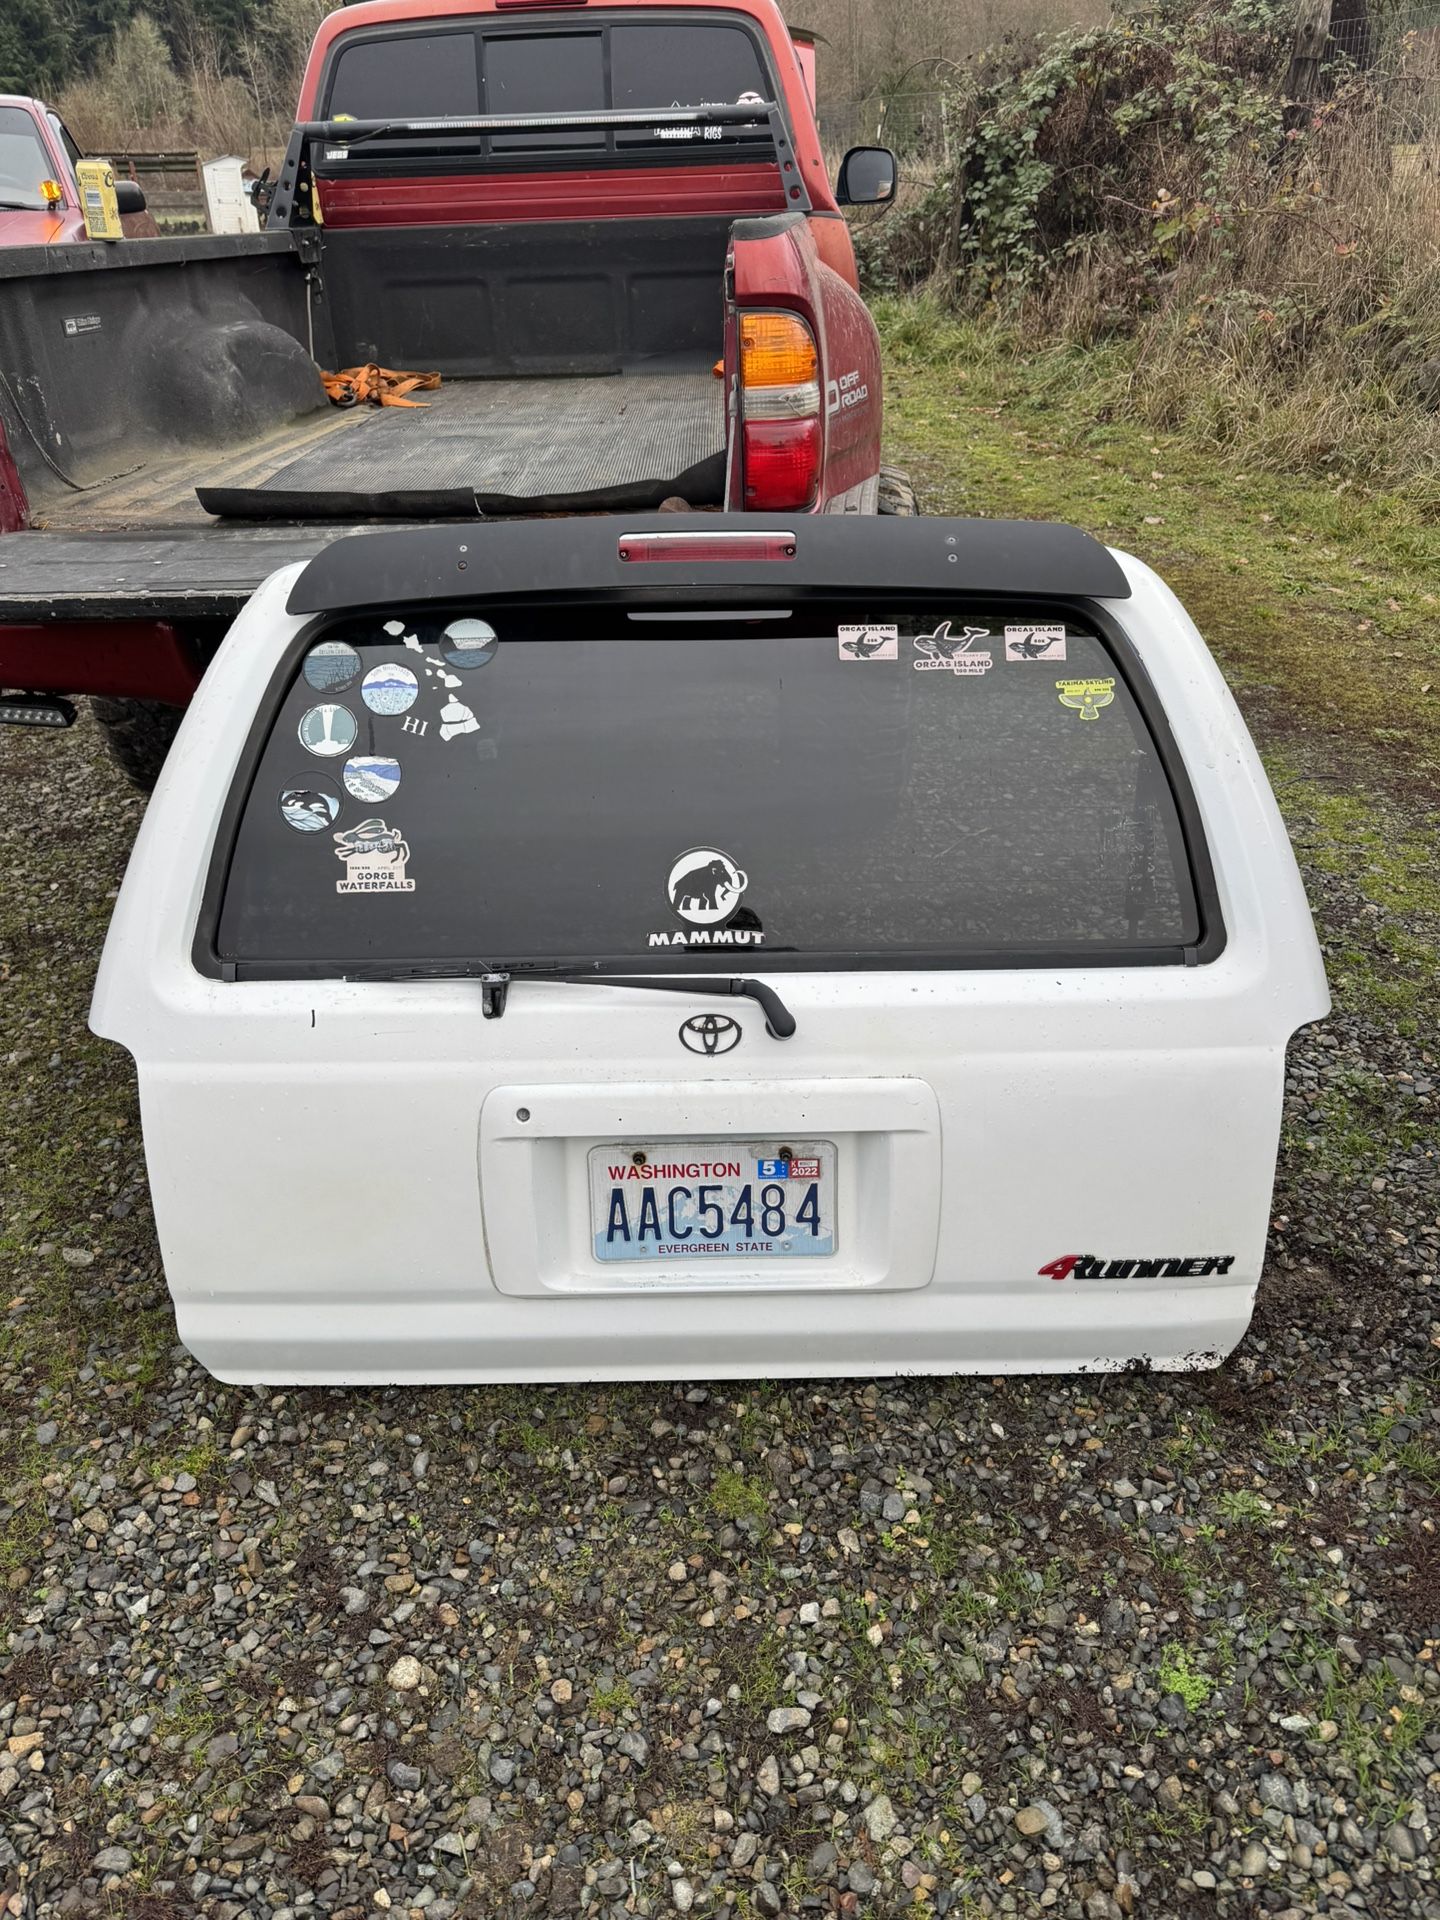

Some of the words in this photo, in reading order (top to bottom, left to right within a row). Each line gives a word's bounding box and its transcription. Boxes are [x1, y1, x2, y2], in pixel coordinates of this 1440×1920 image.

[704, 126, 722, 139] RIGS
[839, 370, 859, 390] OFF
[842, 384, 868, 408] ROAD
[915, 660, 952, 668] ORCAS
[954, 660, 991, 668] ISLAND
[401, 716, 428, 736] HI
[357, 872, 395, 880] GORGE
[339, 881, 413, 890] WATERFALLS
[648, 930, 765, 947] MAMMUT
[608, 1163, 741, 1180] WASHINGTON
[762, 1161, 776, 1175] 5
[791, 1167, 818, 1176] 2022
[607, 1183, 821, 1242] AAC5484
[658, 1244, 730, 1254] EVERGREEN
[735, 1243, 773, 1252] STATE
